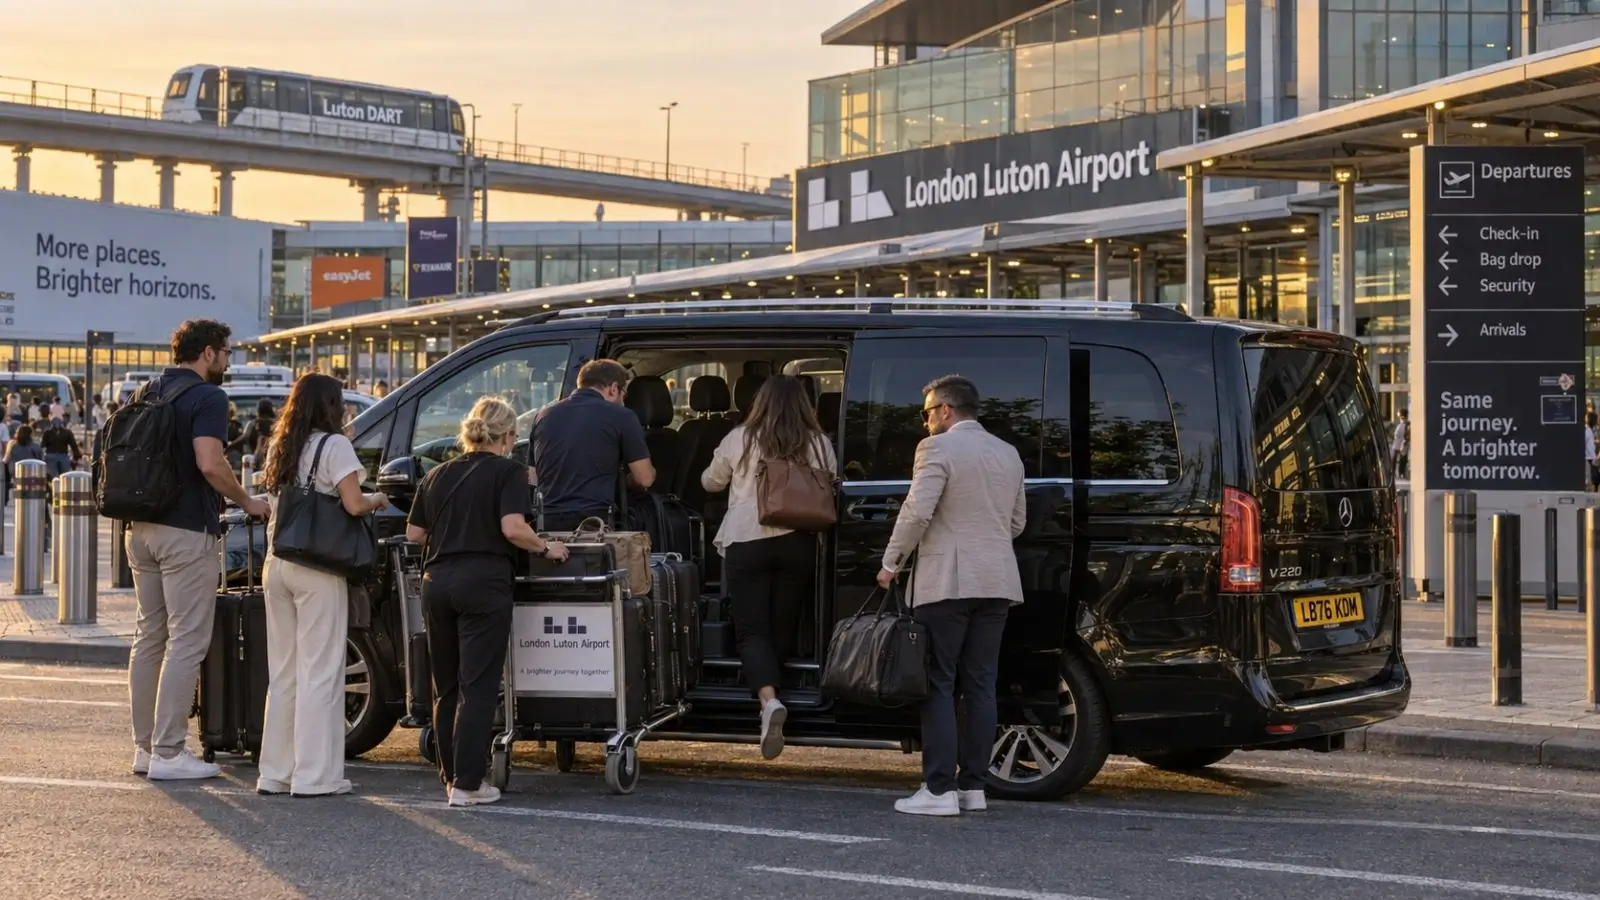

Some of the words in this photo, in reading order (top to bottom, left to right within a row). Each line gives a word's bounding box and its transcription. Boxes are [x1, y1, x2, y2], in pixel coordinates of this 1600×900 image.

[323, 98, 365, 121] Luton
[367, 104, 403, 125] DART
[905, 167, 978, 208] London
[984, 160, 1049, 197] Luton
[1056, 140, 1150, 193] Airport
[1481, 163, 1572, 182] Departures
[1480, 226, 1539, 240] Check-in
[36, 233, 89, 260] More
[95, 239, 167, 267] places.
[1480, 252, 1505, 269] Bag
[1509, 252, 1542, 269] drop
[36, 266, 123, 298] Brighter
[129, 272, 216, 300] horizons.
[323, 269, 372, 284] easyJet
[1480, 278, 1536, 295] Security
[1480, 323, 1527, 336] Arrivals
[1440, 391, 1493, 409] Same
[1439, 413, 1518, 436] journey.
[1442, 439, 1456, 456] A
[1461, 438, 1537, 460] brighter
[1442, 462, 1540, 480] tomorrow.
[1269, 568, 1278, 578] V
[1280, 566, 1302, 577] 220
[1301, 599, 1332, 623] LB76
[1335, 596, 1358, 619] KDM
[520, 639, 550, 648] London
[553, 639, 578, 649] Luton
[581, 639, 610, 651] Airport
[553, 668, 579, 676] journey
[581, 668, 610, 676] together
